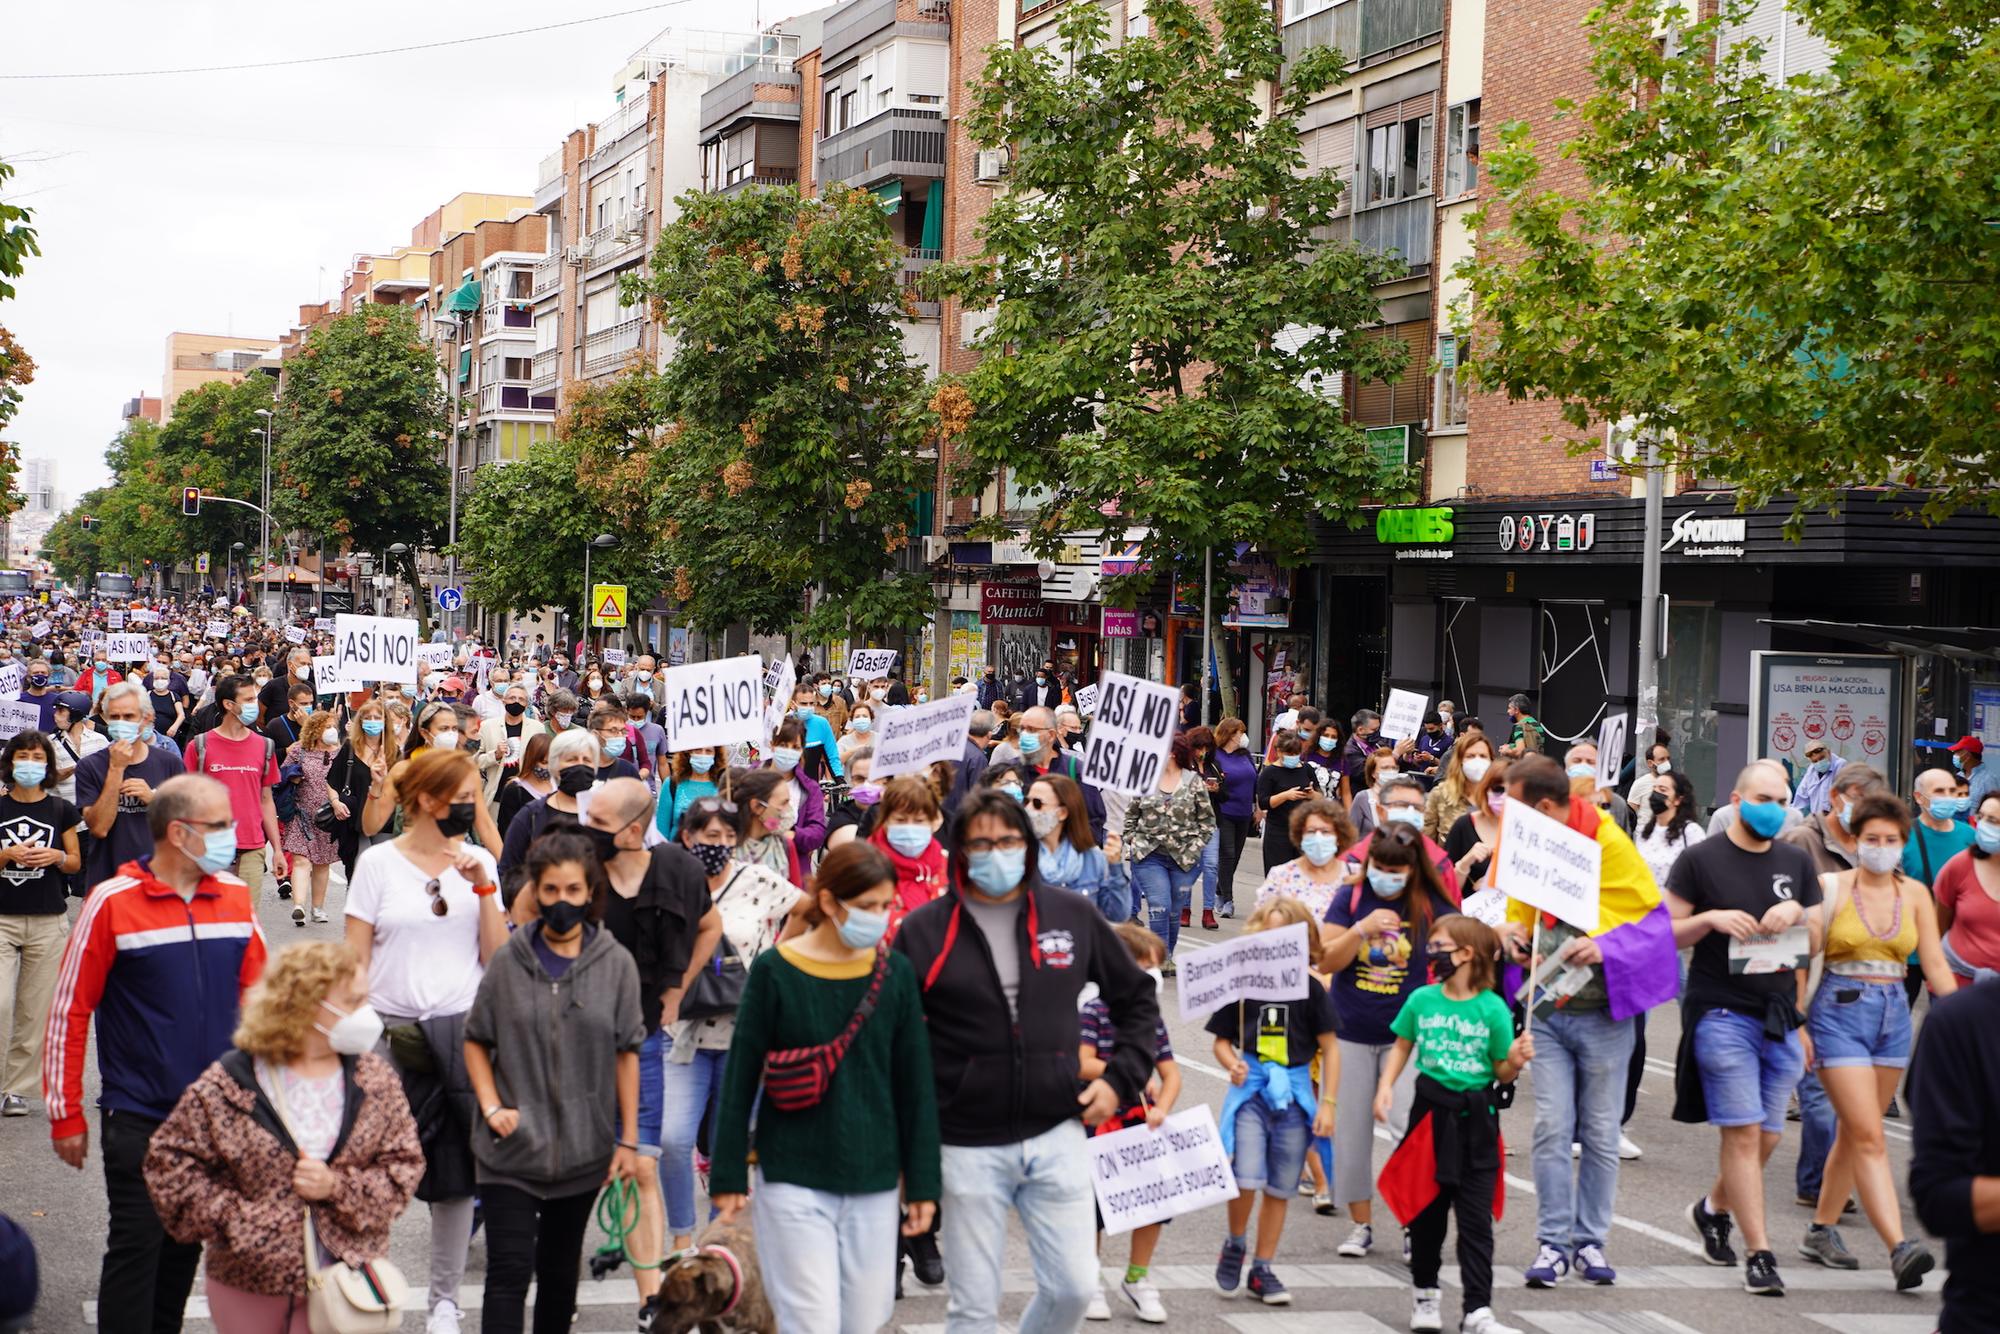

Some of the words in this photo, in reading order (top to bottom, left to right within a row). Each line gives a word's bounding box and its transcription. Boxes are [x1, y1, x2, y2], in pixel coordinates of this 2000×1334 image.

[985, 587, 1040, 599] CAFETERI
[986, 603, 1044, 619] Munich
[1107, 624, 1132, 635] UÑAS
[130, 640, 146, 654] NO!
[338, 625, 376, 670] ¡ASÍ
[384, 633, 413, 667] NO!
[850, 652, 894, 675] ¡Basta!
[317, 665, 336, 689] ¡AS
[1773, 684, 1793, 693] USA
[1794, 684, 1813, 694] BIEN
[1814, 685, 1827, 694] LA
[1828, 685, 1886, 695] MASCARILLA
[673, 674, 715, 741] ¡ASÍ
[723, 679, 759, 721] NO!
[1138, 693, 1171, 739] NO
[1126, 749, 1158, 794] NO
[1280, 966, 1303, 989] NO!
